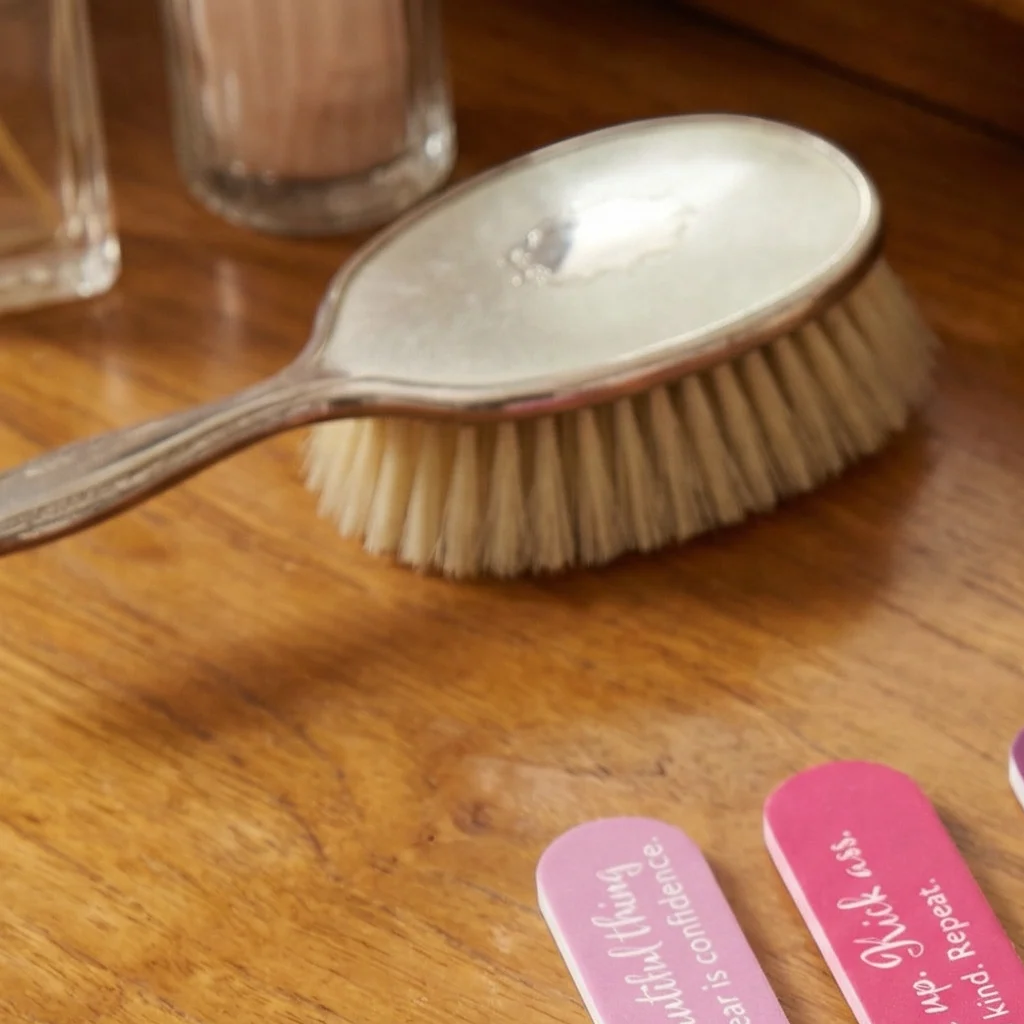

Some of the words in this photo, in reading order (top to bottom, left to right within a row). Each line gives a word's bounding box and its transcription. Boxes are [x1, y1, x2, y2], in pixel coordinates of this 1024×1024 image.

[830, 830, 873, 878] ass.
[591, 862, 652, 941] thing
[642, 836, 718, 964] confidence.
[836, 885, 924, 969] Kick
[919, 878, 976, 961] Repeat.
[701, 970, 731, 992] is
[912, 971, 953, 1014] up.
[960, 963, 1010, 1020] kind.
